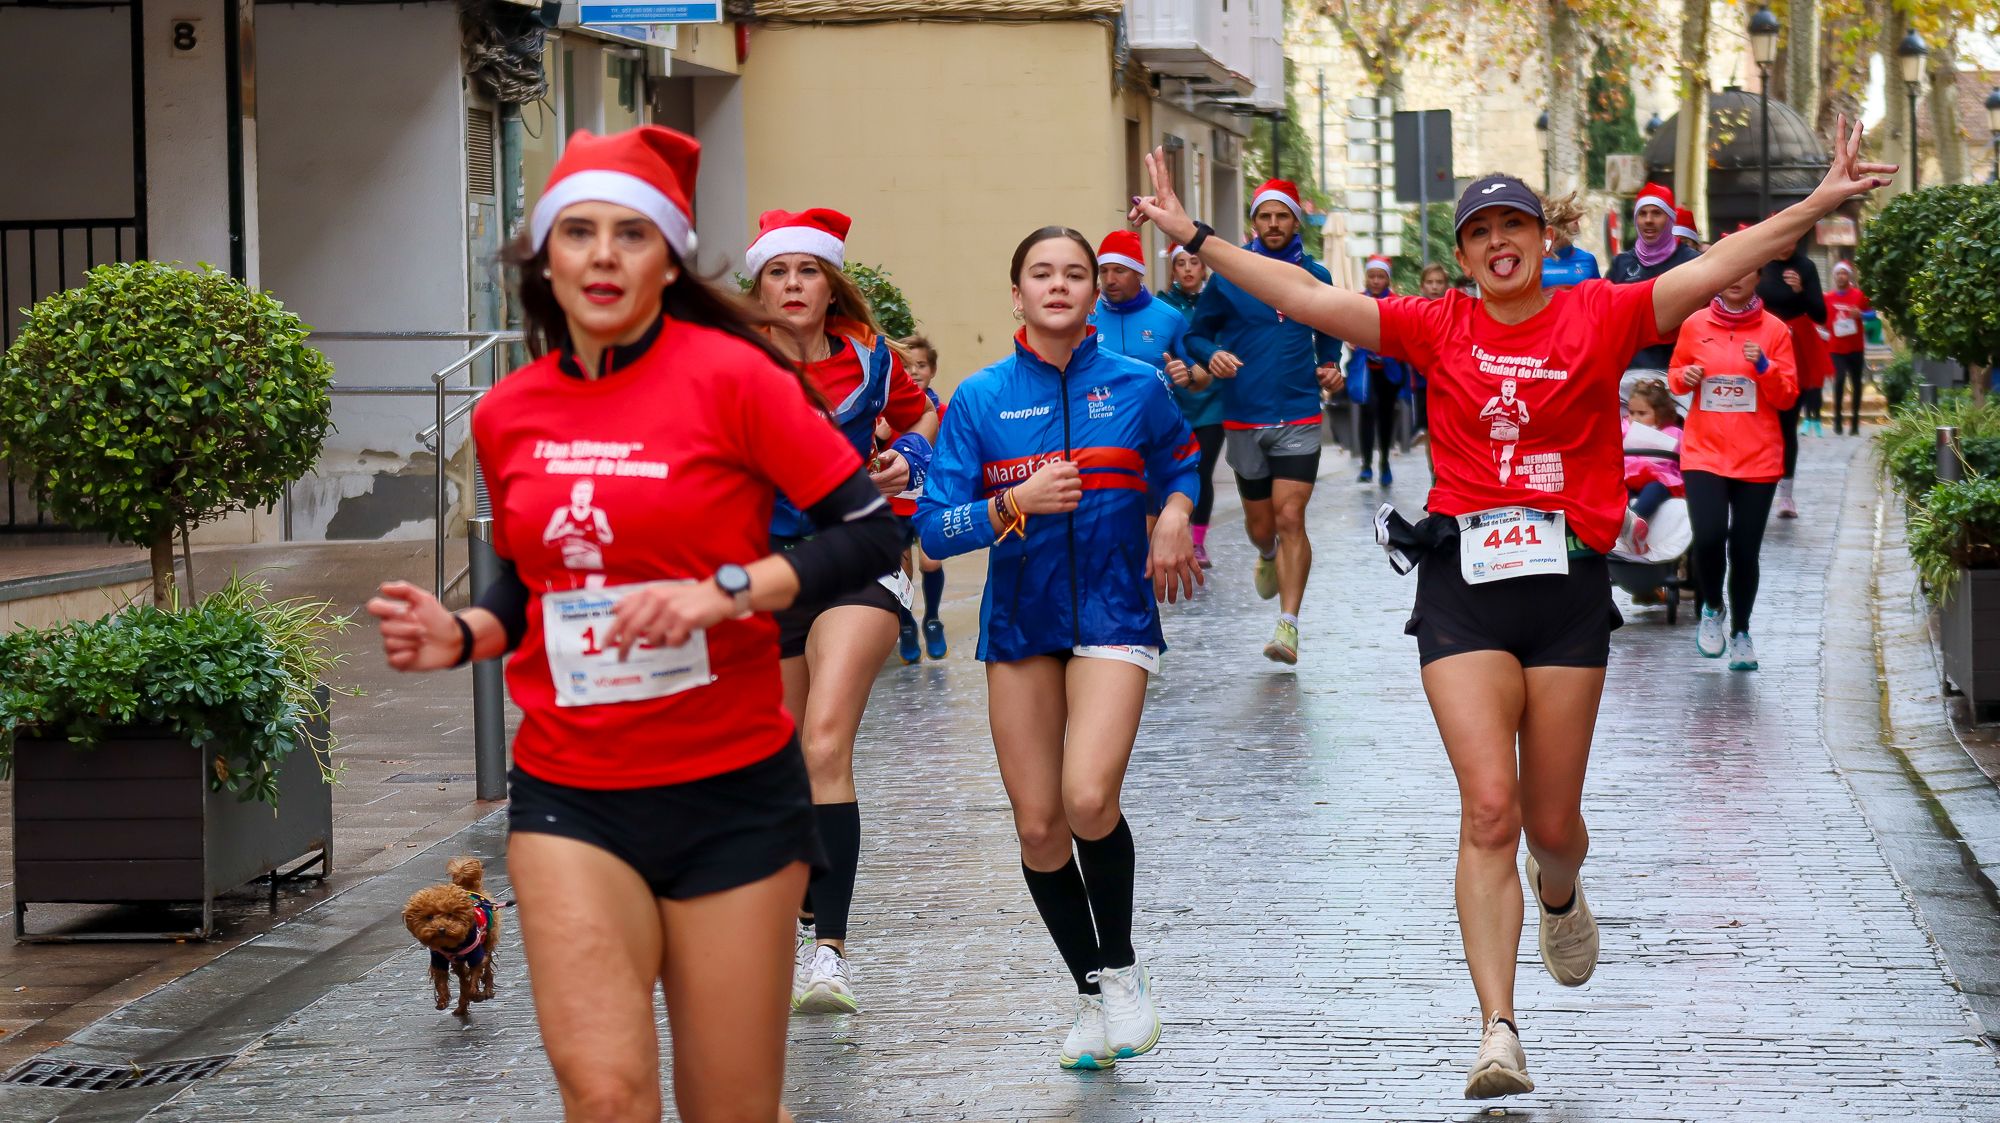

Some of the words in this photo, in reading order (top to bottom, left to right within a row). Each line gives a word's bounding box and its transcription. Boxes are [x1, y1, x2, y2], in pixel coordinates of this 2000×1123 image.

[174, 22, 197, 51] 8
[1476, 348, 1496, 362] San
[1479, 361, 1517, 377] Ciudad
[1517, 367, 1532, 379] de
[1532, 368, 1568, 380] Lucena
[1712, 385, 1744, 397] 479
[1000, 405, 1049, 420] enerplus
[1089, 411, 1113, 419] Lucena
[942, 510, 955, 538] Club
[1483, 525, 1541, 549] 441
